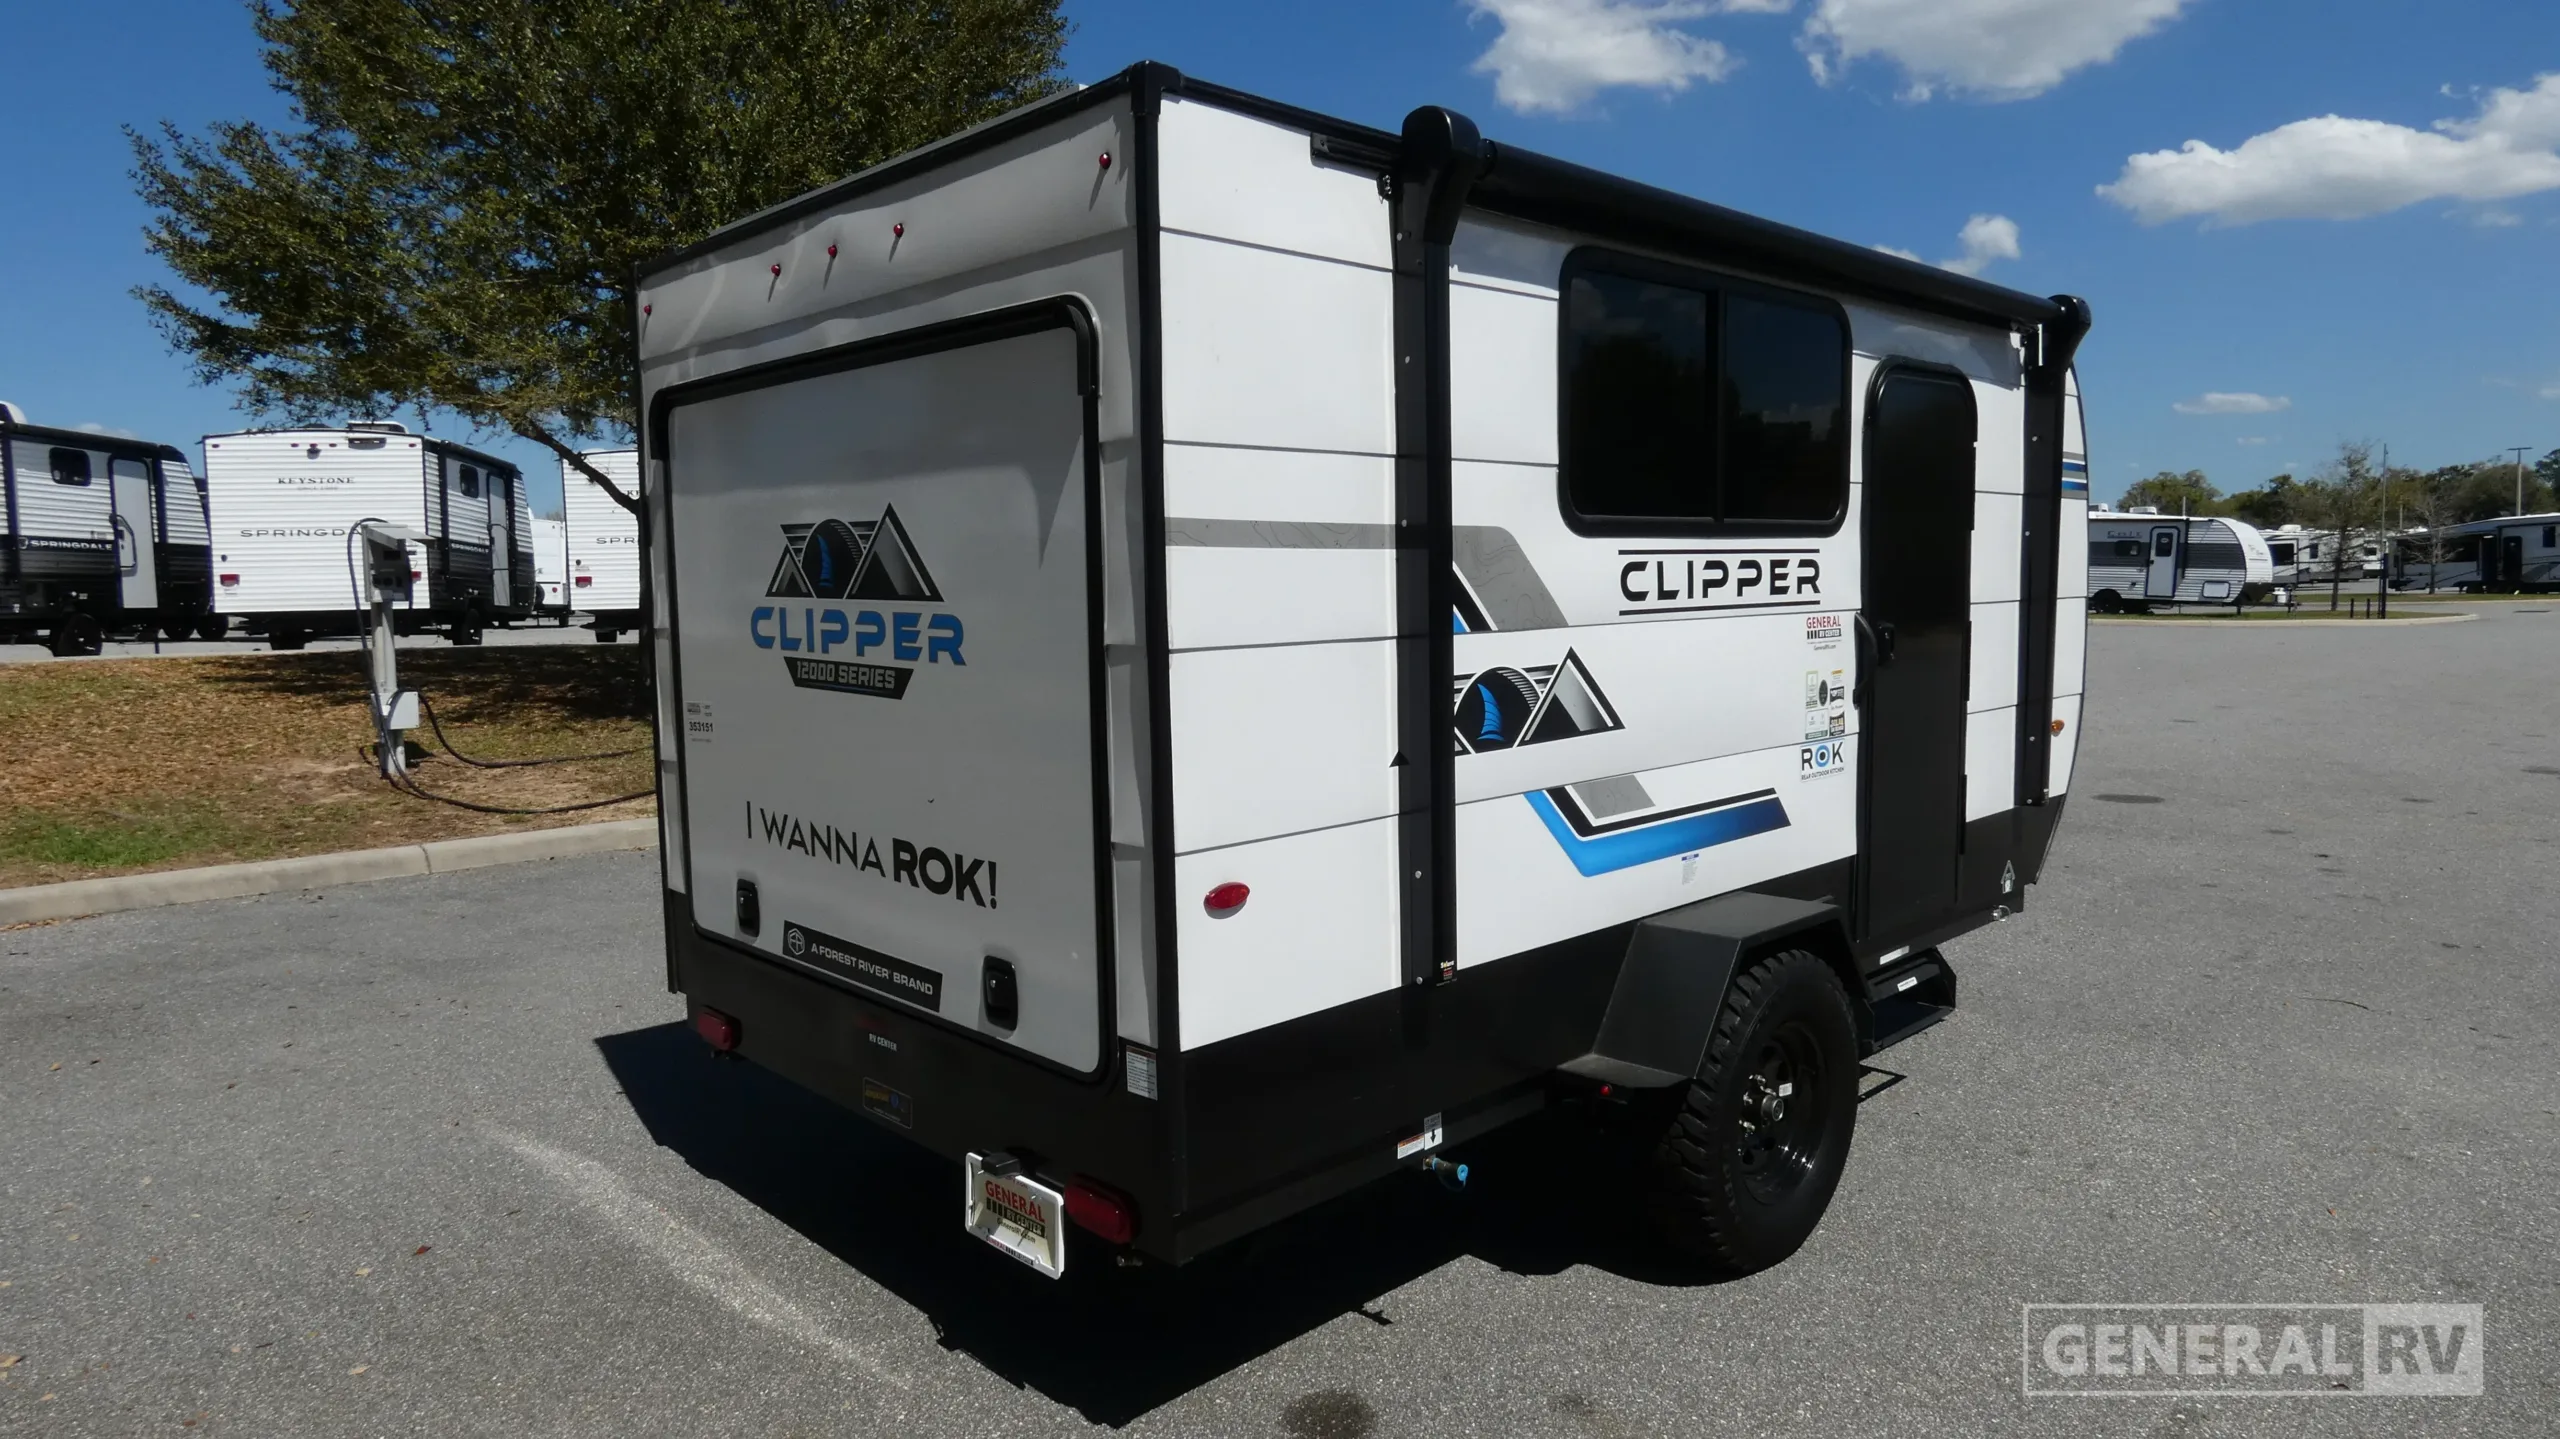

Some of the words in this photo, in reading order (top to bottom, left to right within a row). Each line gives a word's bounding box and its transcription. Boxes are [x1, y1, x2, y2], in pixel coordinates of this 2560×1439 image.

[278, 477, 355, 485] KEYSTONE
[30, 539, 113, 551] SPRINGDALE
[1620, 559, 1821, 602] CLIPPER
[751, 606, 967, 666] CLIPPER
[1806, 615, 1841, 629] GENERAL
[797, 661, 835, 682] 12000
[838, 666, 896, 689] SERIES
[689, 721, 714, 732] 353151
[1801, 741, 1844, 771] ROK
[747, 801, 752, 839] I
[759, 807, 886, 878] WANNA
[892, 837, 997, 910] ROK!
[811, 943, 819, 955] A
[819, 945, 857, 968] FOREST
[858, 959, 889, 980] RIVER
[893, 972, 933, 995] BRAND
[868, 1033, 876, 1043] RV
[877, 1036, 897, 1051] CENTER
[985, 1180, 1046, 1224] GENERAL
[1006, 1210, 1016, 1220] RV
[1017, 1216, 1043, 1235] CENTER
